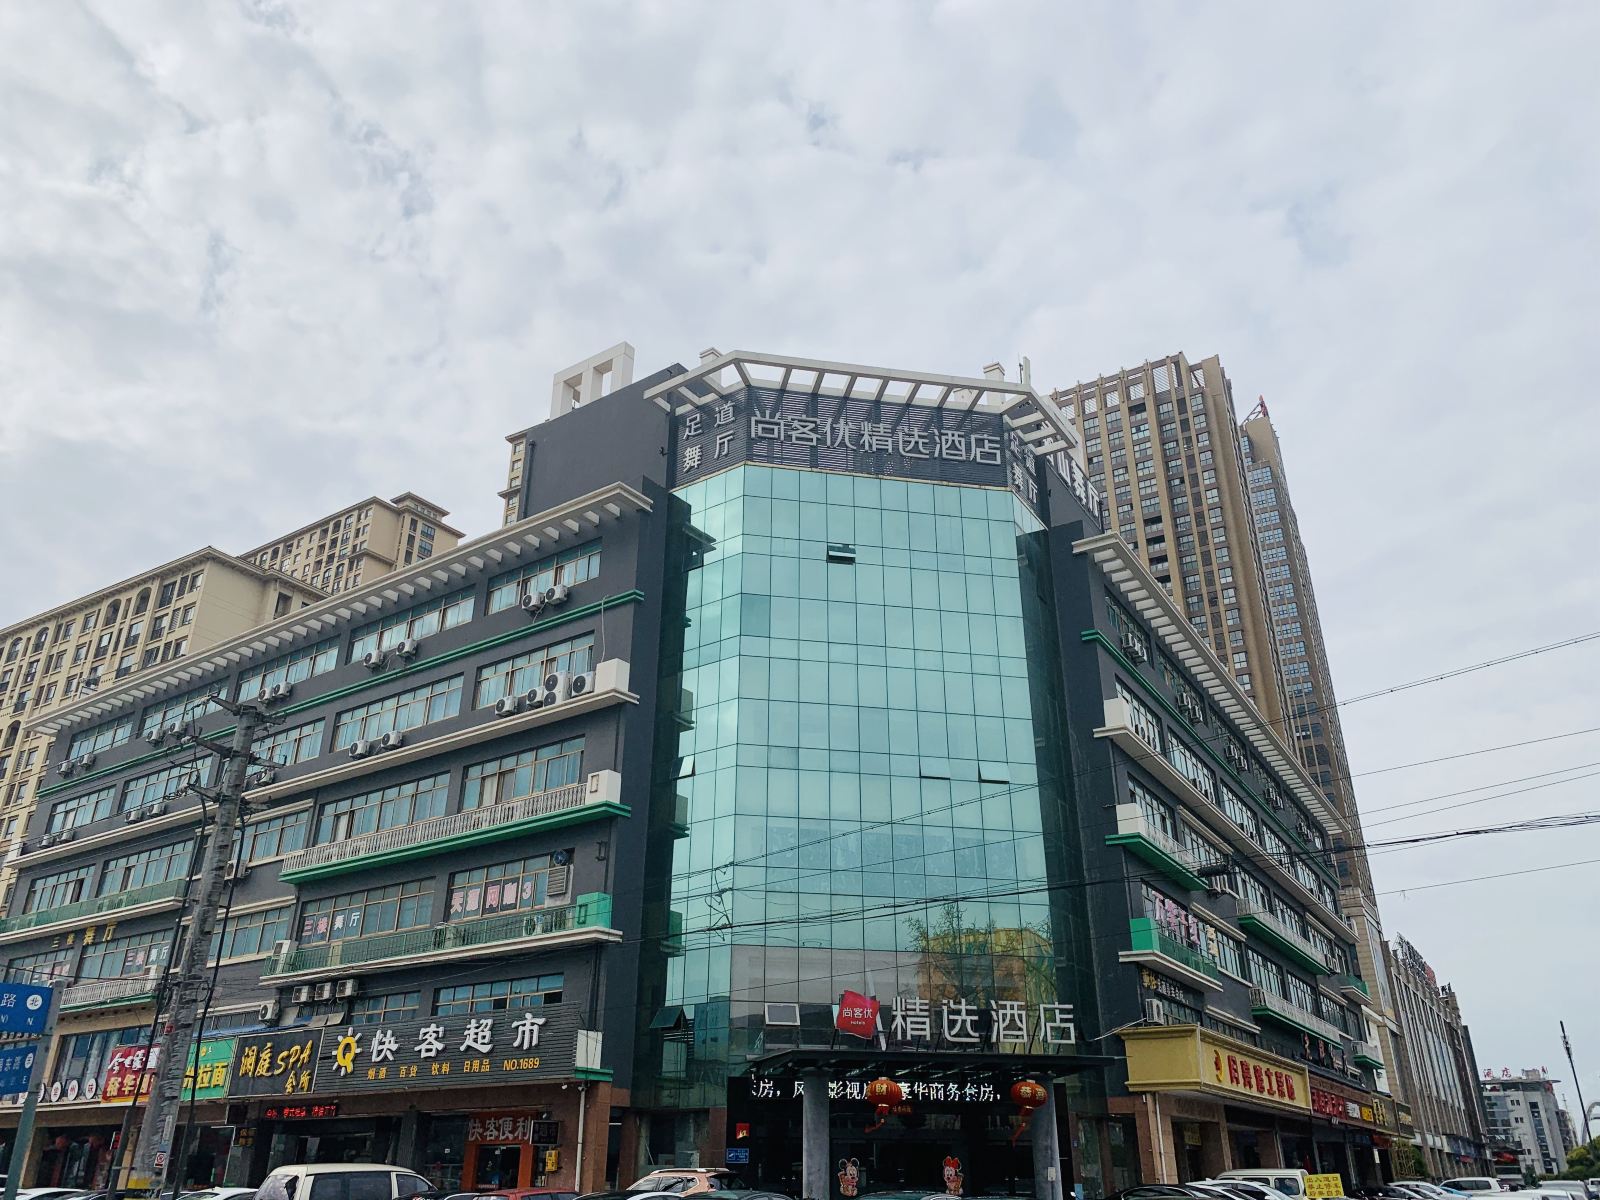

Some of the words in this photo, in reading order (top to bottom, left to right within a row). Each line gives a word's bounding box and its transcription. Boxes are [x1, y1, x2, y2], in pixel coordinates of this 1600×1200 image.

[750, 408, 1001, 465] 尚客优精选酒店
[843, 1007, 873, 1018] 尚客优
[891, 996, 1076, 1045] 精选酒店
[370, 1012, 547, 1063] 快客超市
[399, 1065, 418, 1078] 百货
[431, 1062, 450, 1075] 饮料
[463, 1059, 490, 1073] 日用品
[503, 1057, 540, 1071] NO.1689
[468, 1115, 531, 1141] 快客便利
